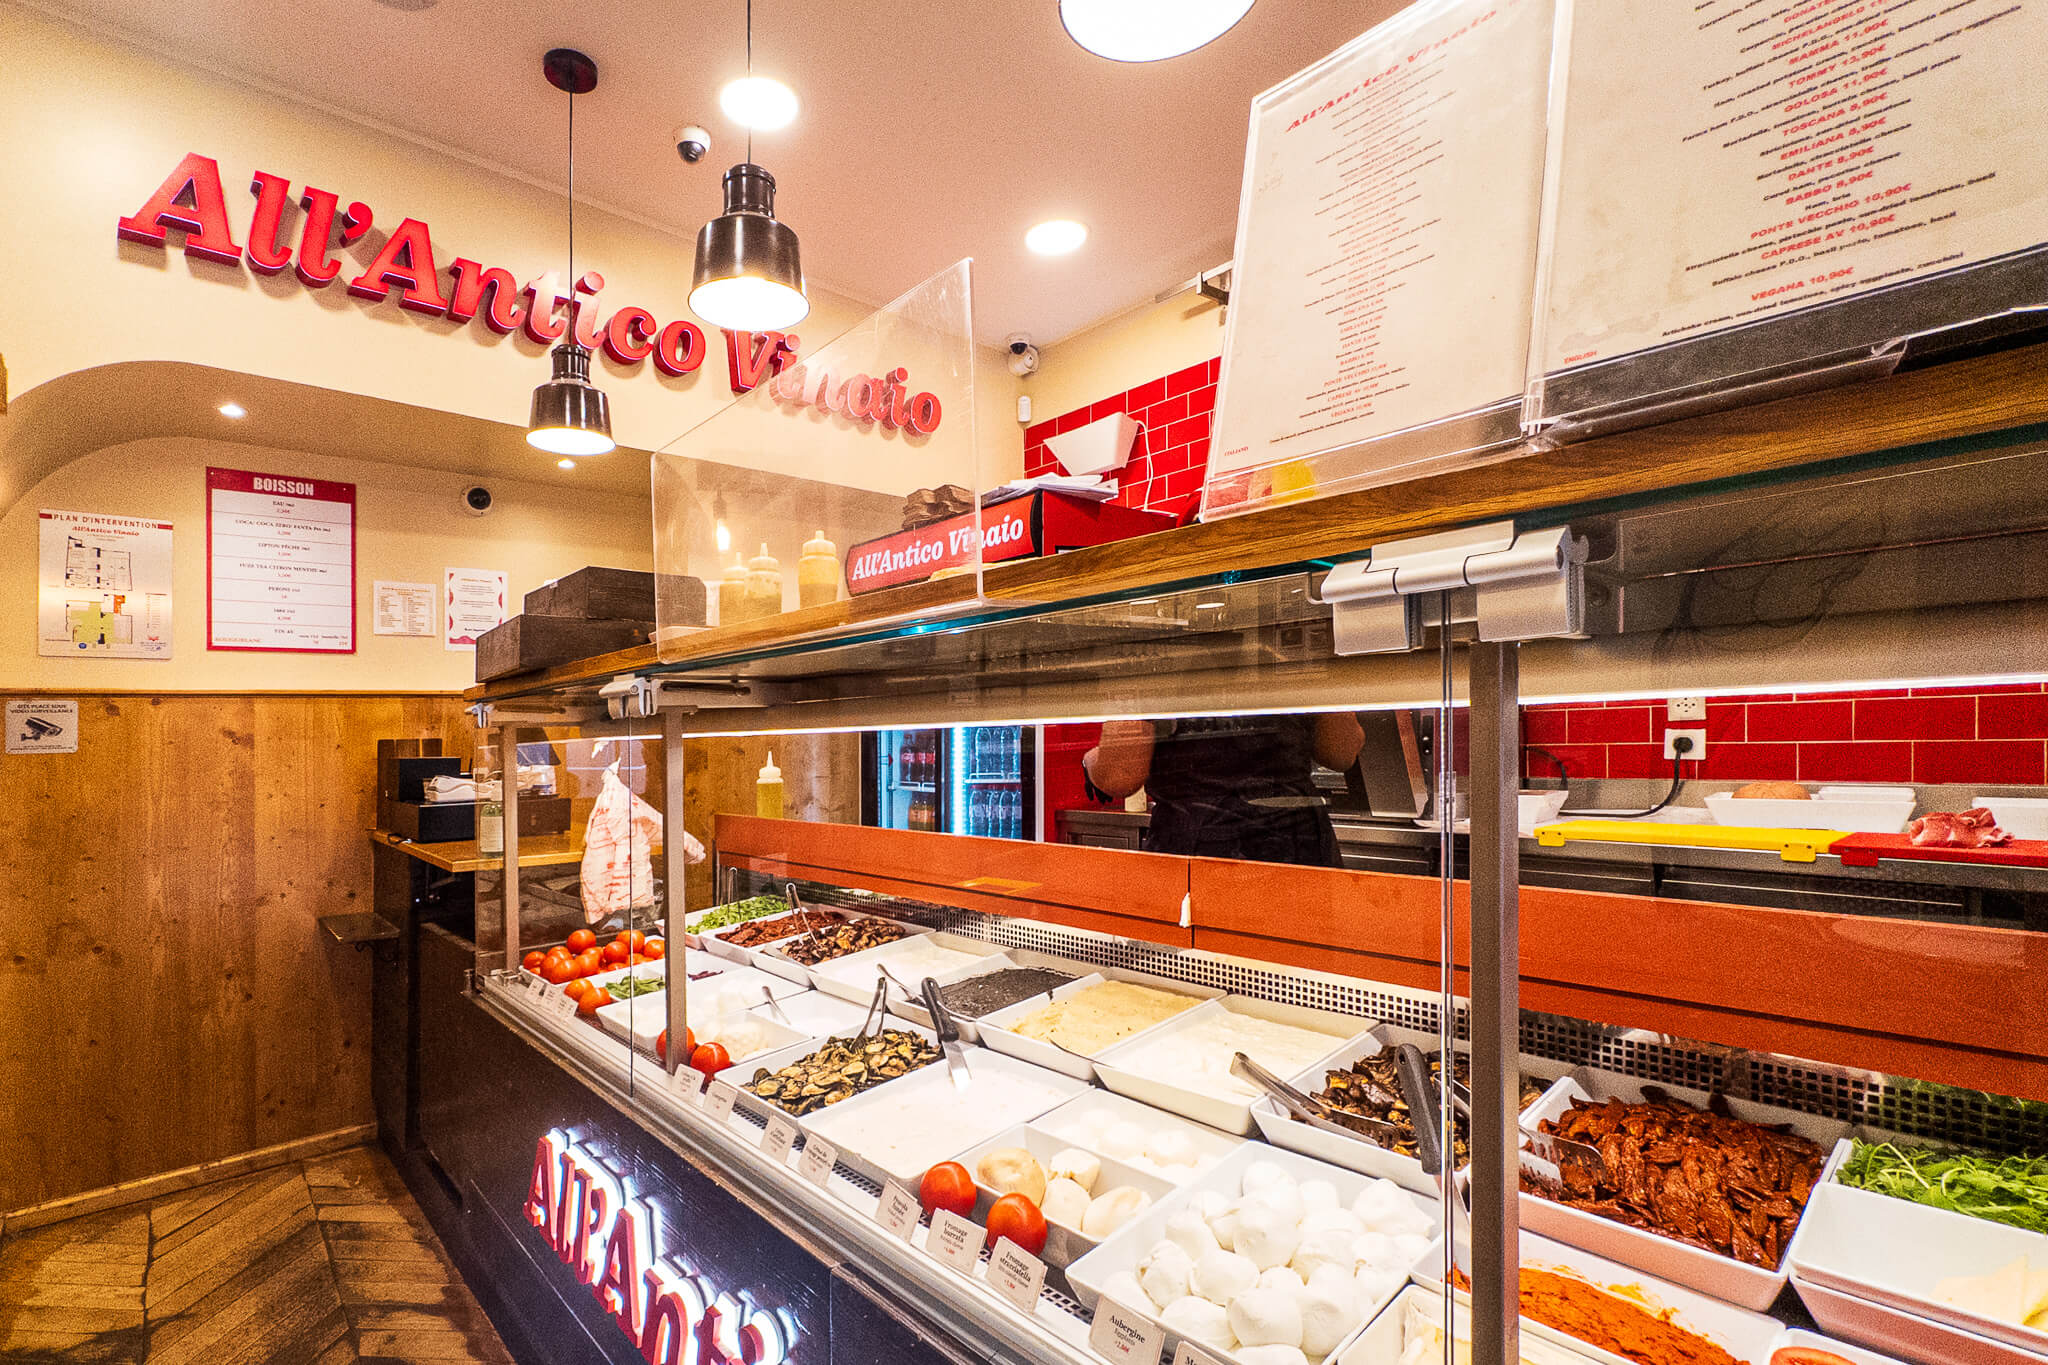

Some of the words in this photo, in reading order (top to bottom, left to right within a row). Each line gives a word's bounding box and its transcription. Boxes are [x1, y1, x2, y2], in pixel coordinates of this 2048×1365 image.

[1772, 6, 1865, 50] MICHELANGELO
[1789, 40, 1840, 65] MAMMA
[1789, 63, 1837, 88] TOMMY
[1784, 88, 1838, 113] GOLOSA
[1783, 108, 1846, 137] TOSCANA
[1780, 132, 1845, 161] EMILIANA
[1788, 159, 1833, 182] DANTE
[1836, 145, 1875, 164] 8,90€
[1785, 184, 1832, 206] BABBO
[1835, 170, 1874, 189] 8,90€
[1750, 219, 1794, 240] PONTE
[1797, 200, 1860, 225] VECCHIO
[1864, 182, 1913, 204] 10,90€
[1712, 273, 1742, 287] Buffalo
[1744, 264, 1777, 277] cheese
[1930, 211, 1957, 224] basil
[1760, 236, 1822, 260] CAPRESE
[1824, 229, 1845, 241] AV
[1849, 214, 1897, 234] 10,90€
[117, 152, 705, 376] All'Antico
[1751, 280, 1805, 301] VEGANA
[1809, 266, 1854, 285] 10,90€
[1564, 351, 1597, 364] ENGLISH
[254, 477, 314, 496] BOISSON
[53, 514, 78, 522] PLAN
[82, 516, 157, 529] D'INTERVENTION
[852, 540, 944, 581] All'Antico
[949, 515, 1024, 557] Vinaio
[1110, 1315, 1146, 1344] Aubergine
